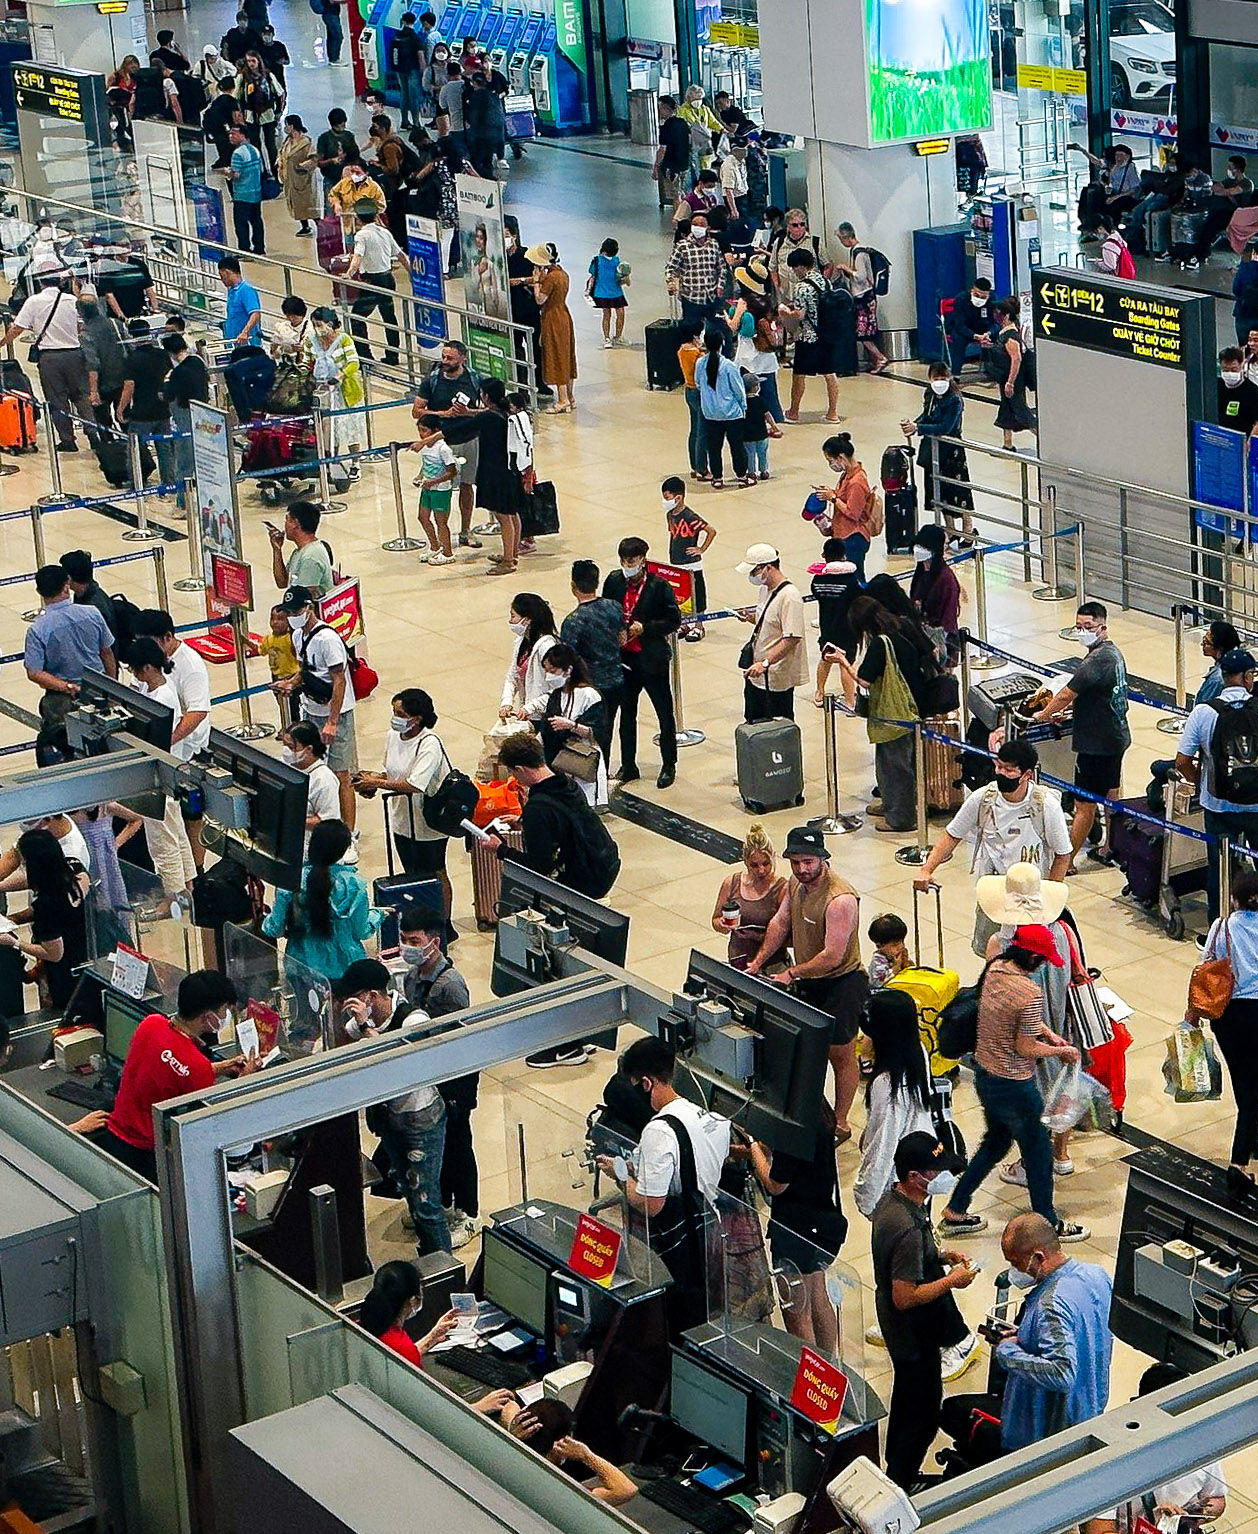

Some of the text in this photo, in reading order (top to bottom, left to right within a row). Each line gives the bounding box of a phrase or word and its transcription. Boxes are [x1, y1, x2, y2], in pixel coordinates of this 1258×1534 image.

[459, 190, 487, 205] BAMBOO
[412, 255, 426, 277] 40
[1070, 288, 1078, 308] 1
[1090, 292, 1105, 314] 12
[1119, 296, 1180, 319] CỬA RA TÀU BAY
[416, 306, 431, 328] 15
[1128, 311, 1181, 332] Boarding Gates
[1132, 342, 1181, 363] Ticket Counter
[803, 1368, 840, 1401] ĐÓNG QUẦY
[806, 1388, 828, 1411] CLOSED
